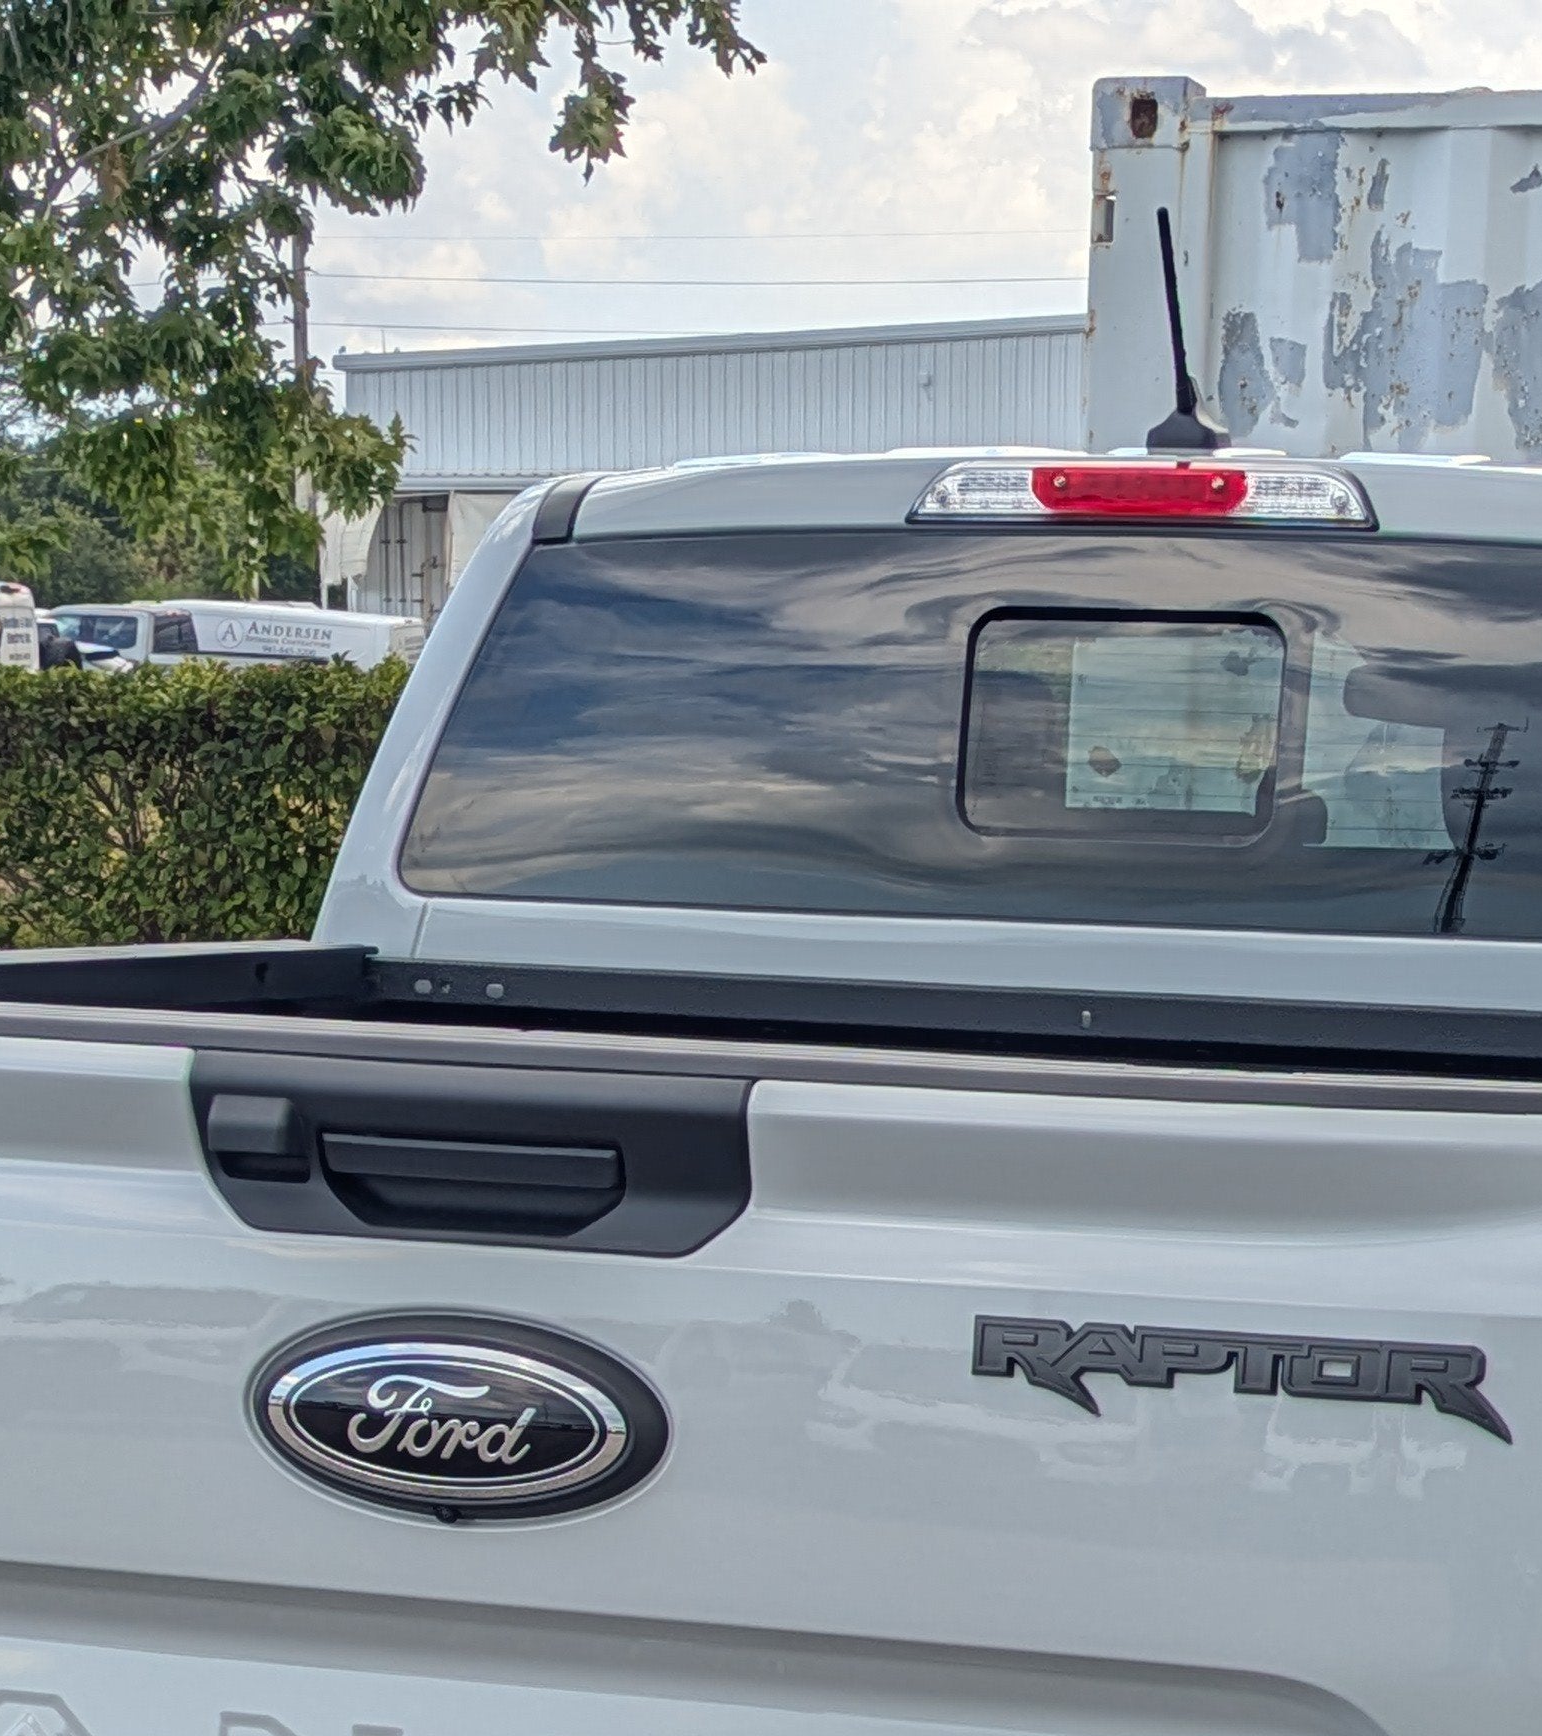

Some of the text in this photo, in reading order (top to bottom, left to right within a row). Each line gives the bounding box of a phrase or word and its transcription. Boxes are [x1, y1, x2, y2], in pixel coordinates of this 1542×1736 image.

[247, 621, 333, 641] ANDERSEN
[346, 1373, 538, 1466] Ford
[971, 1314, 1513, 1445] RAPTOR
